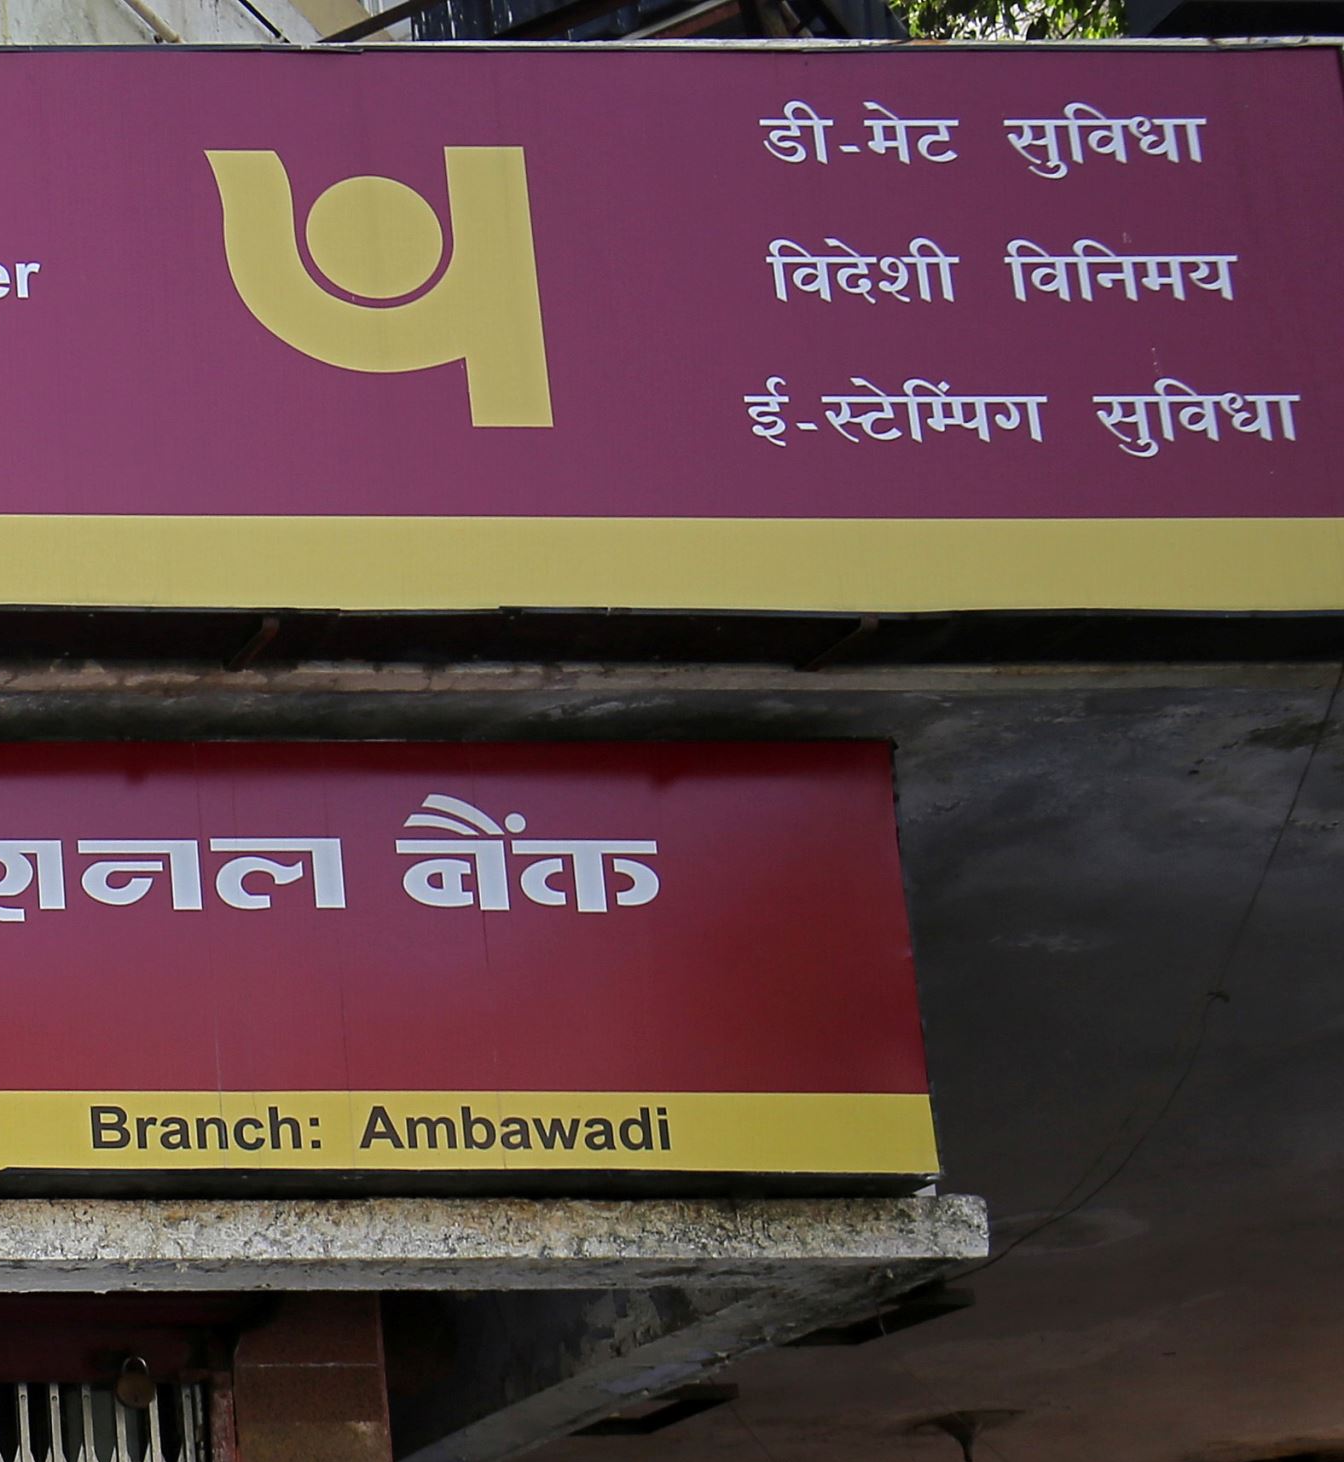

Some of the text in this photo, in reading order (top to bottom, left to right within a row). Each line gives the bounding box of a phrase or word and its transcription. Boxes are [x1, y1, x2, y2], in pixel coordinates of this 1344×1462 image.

[759, 100, 1206, 179] डी-मेट सुविधा
[766, 237, 1237, 303] विदेशी विनिमय
[1092, 377, 1300, 457] सुविधा
[395, 793, 661, 913] बैंक
[89, 1105, 673, 1151] Branch: Ambawadi
